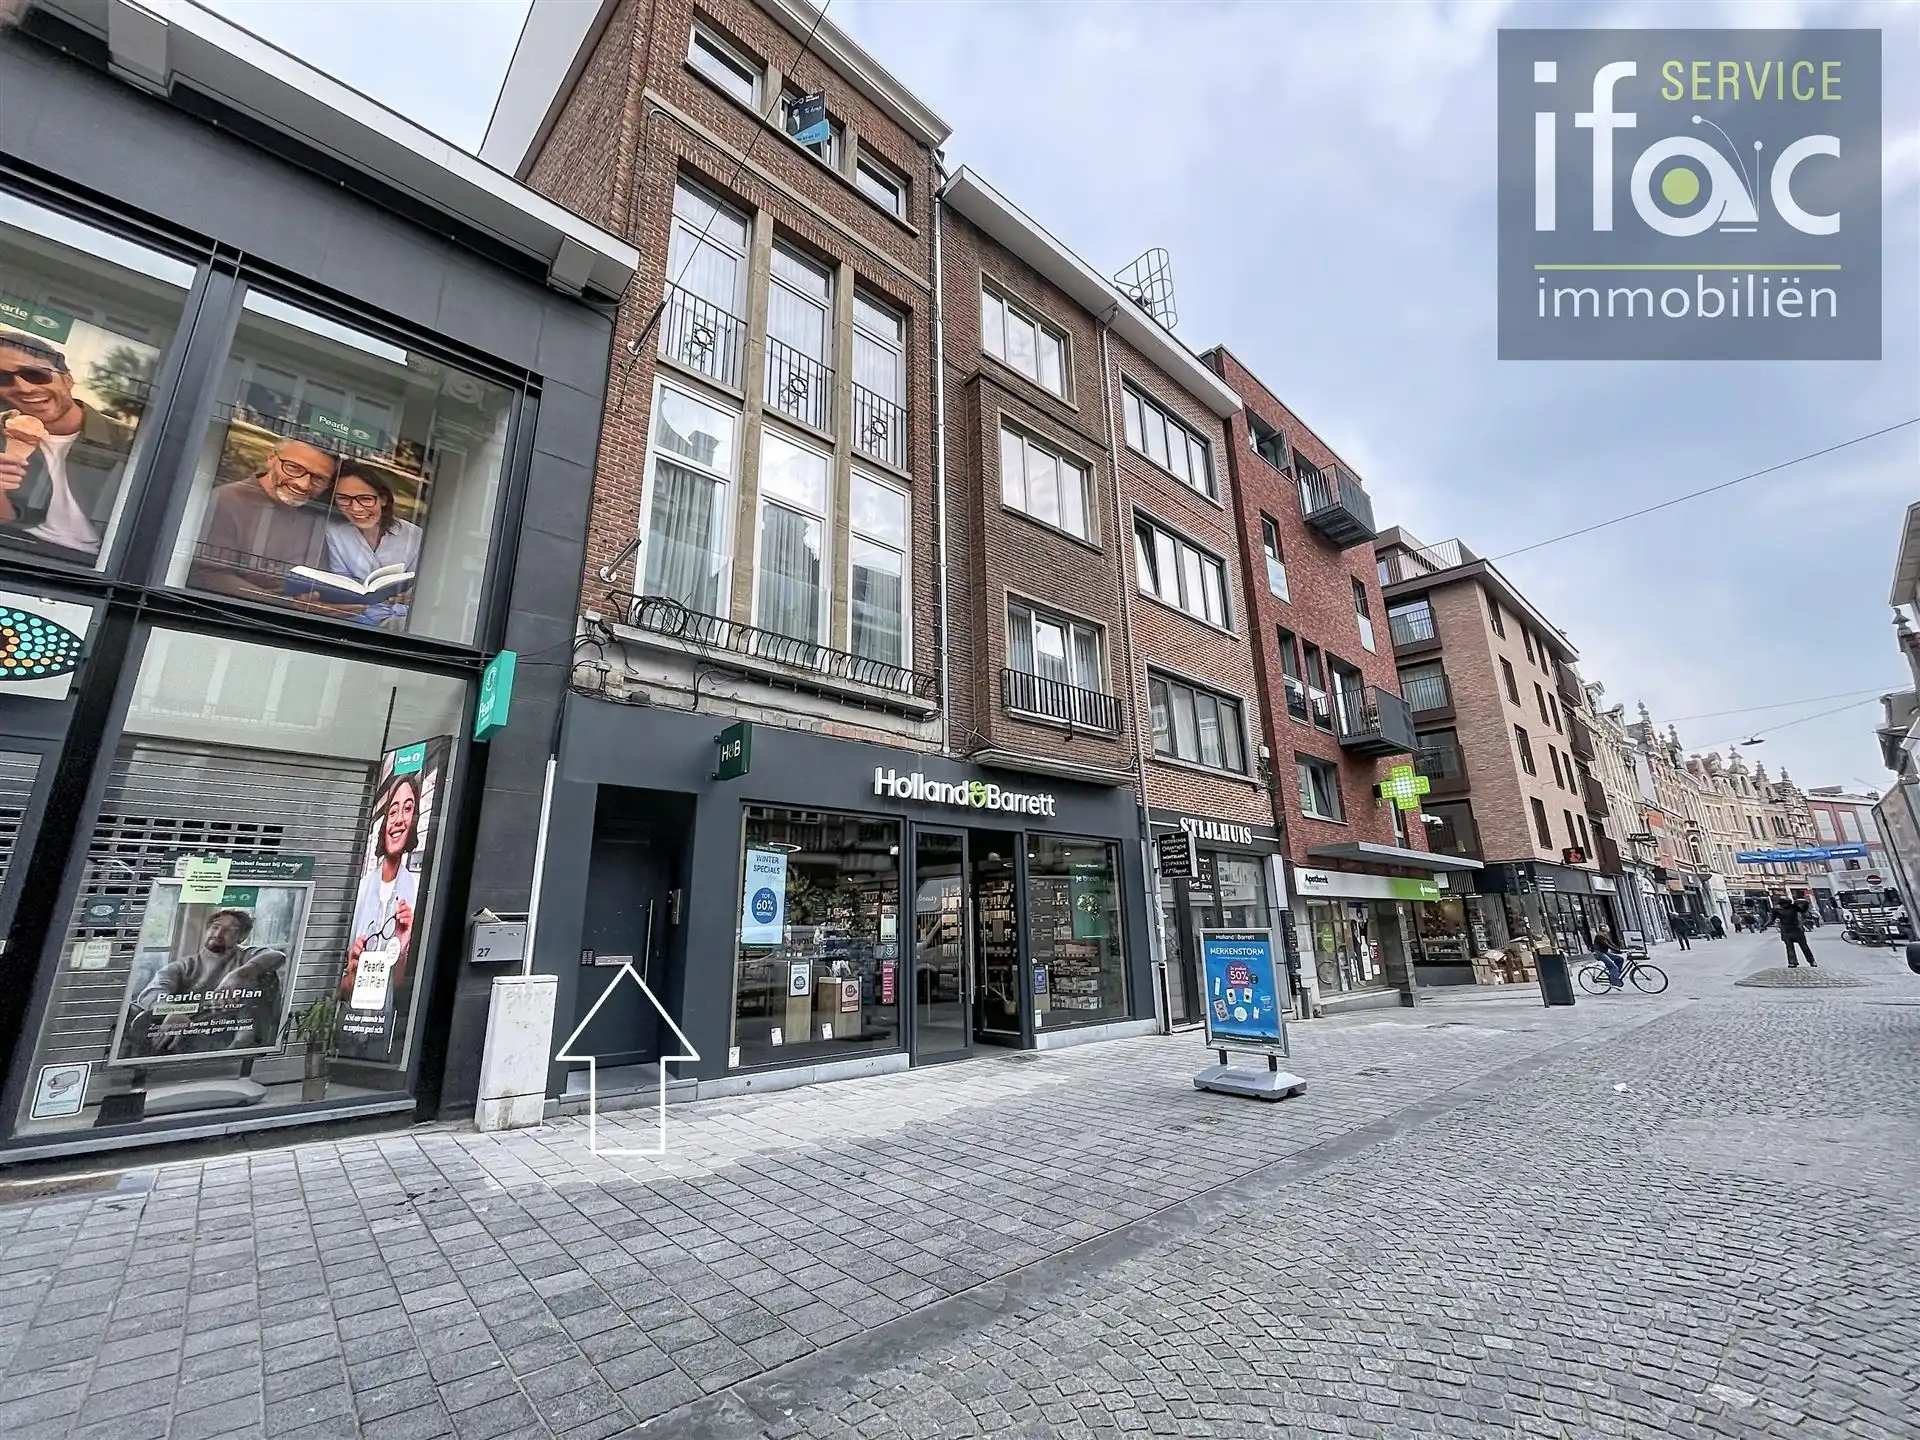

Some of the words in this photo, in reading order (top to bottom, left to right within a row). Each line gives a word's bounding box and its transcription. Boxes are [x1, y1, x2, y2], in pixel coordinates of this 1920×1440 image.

[0, 303, 28, 317] arle
[319, 415, 350, 432] Pearle
[1180, 817, 1252, 845] STIJLHUIS
[756, 854, 780, 865] WINTER
[753, 864, 781, 875] SPECIALS
[756, 900, 774, 911] 60%
[476, 947, 491, 958] 27
[363, 959, 386, 972] Pearle
[1230, 970, 1249, 981] 50%
[156, 991, 202, 1003] Pearle
[204, 989, 229, 1001] Bril
[232, 988, 263, 999] Plan
[210, 1018, 236, 1026] brillen
[183, 1027, 211, 1036] bedrag
[211, 1025, 226, 1034] per
